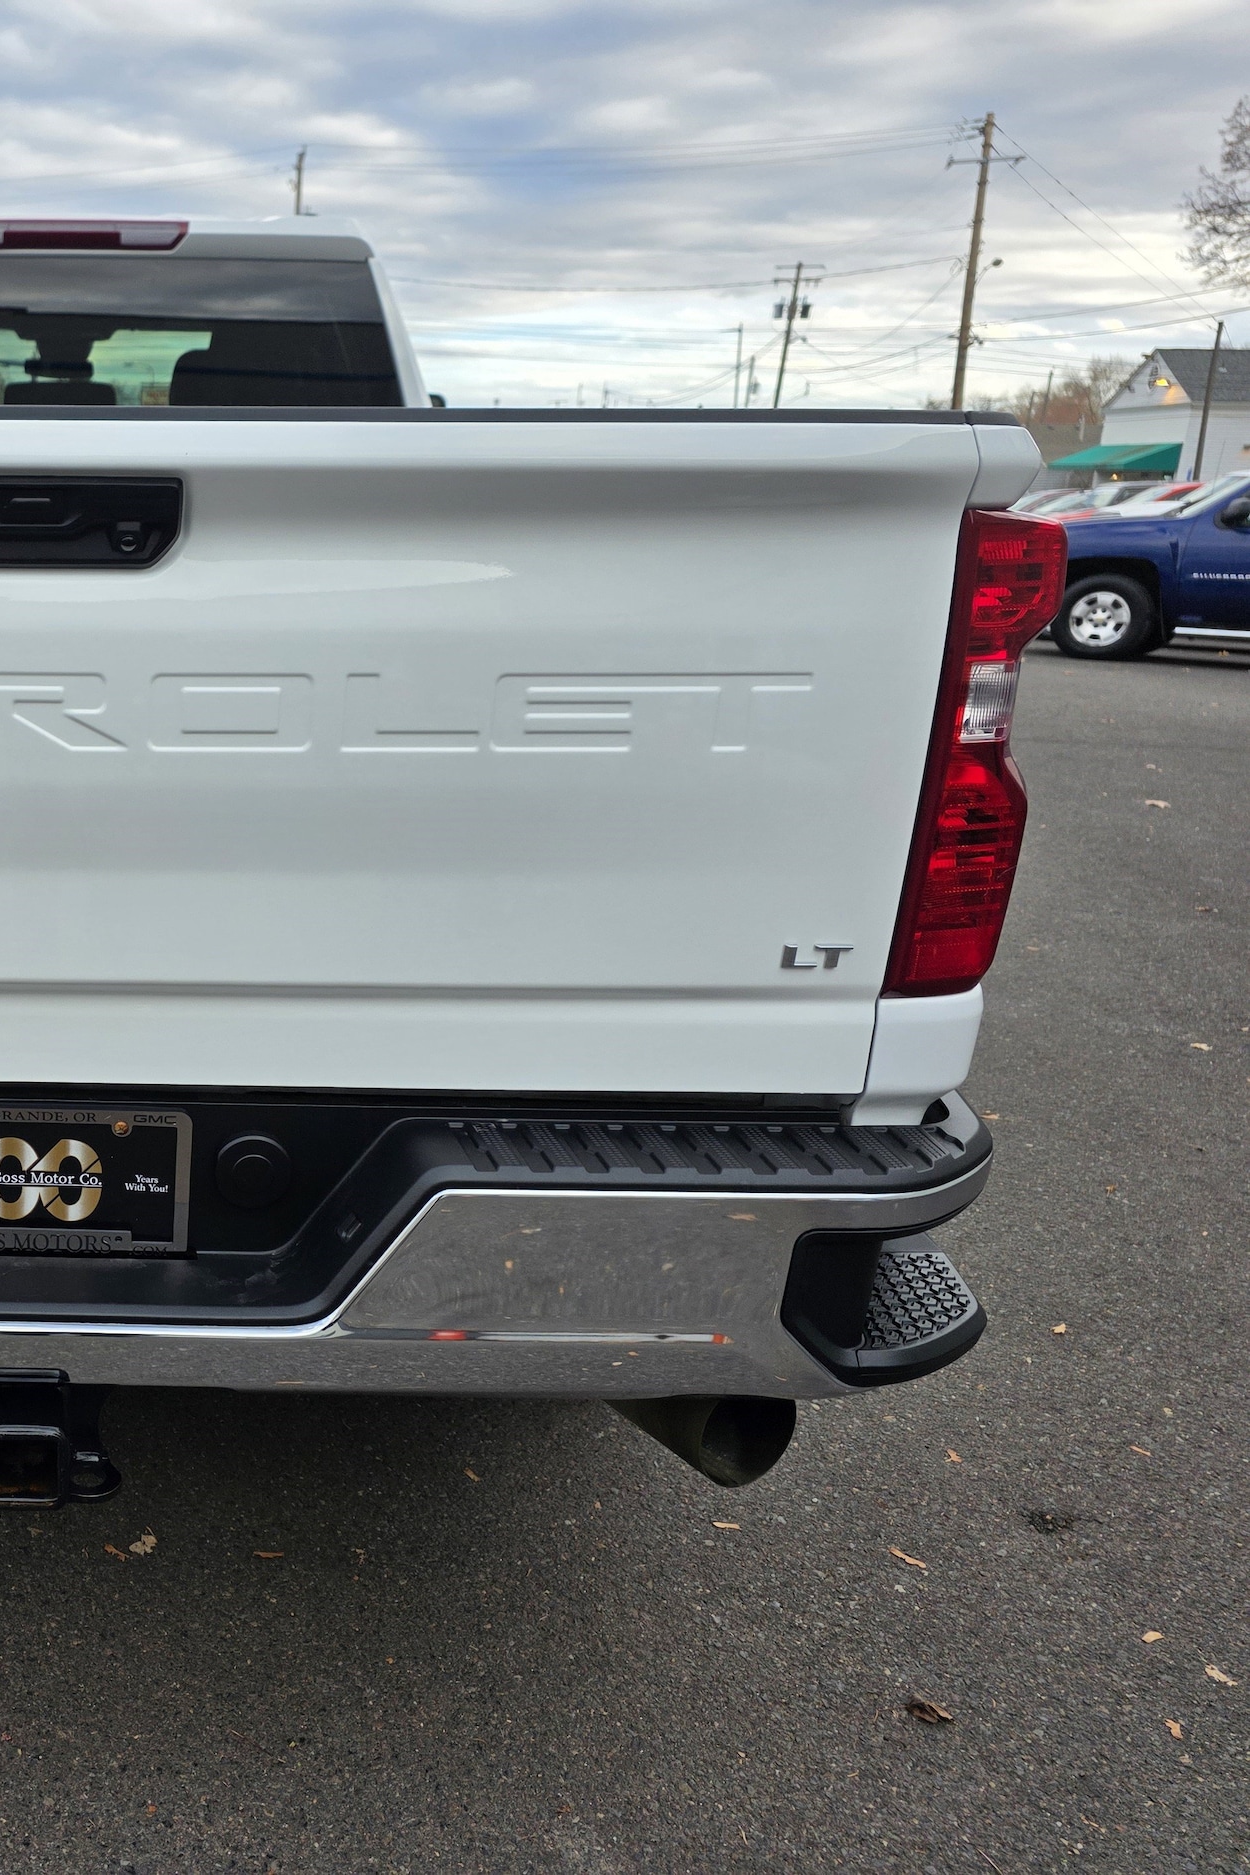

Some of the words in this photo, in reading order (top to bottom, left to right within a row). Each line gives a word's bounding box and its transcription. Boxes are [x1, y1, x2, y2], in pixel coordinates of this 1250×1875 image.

[780, 944, 854, 969] LT
[73, 1112, 97, 1122] OR
[133, 1114, 177, 1125] GMC
[30, 1172, 75, 1185] Motor
[79, 1173, 103, 1186] Co.
[135, 1174, 159, 1184] Years
[124, 1182, 146, 1192] With
[149, 1183, 169, 1193] You!
[12, 1233, 113, 1254] MOTORS
